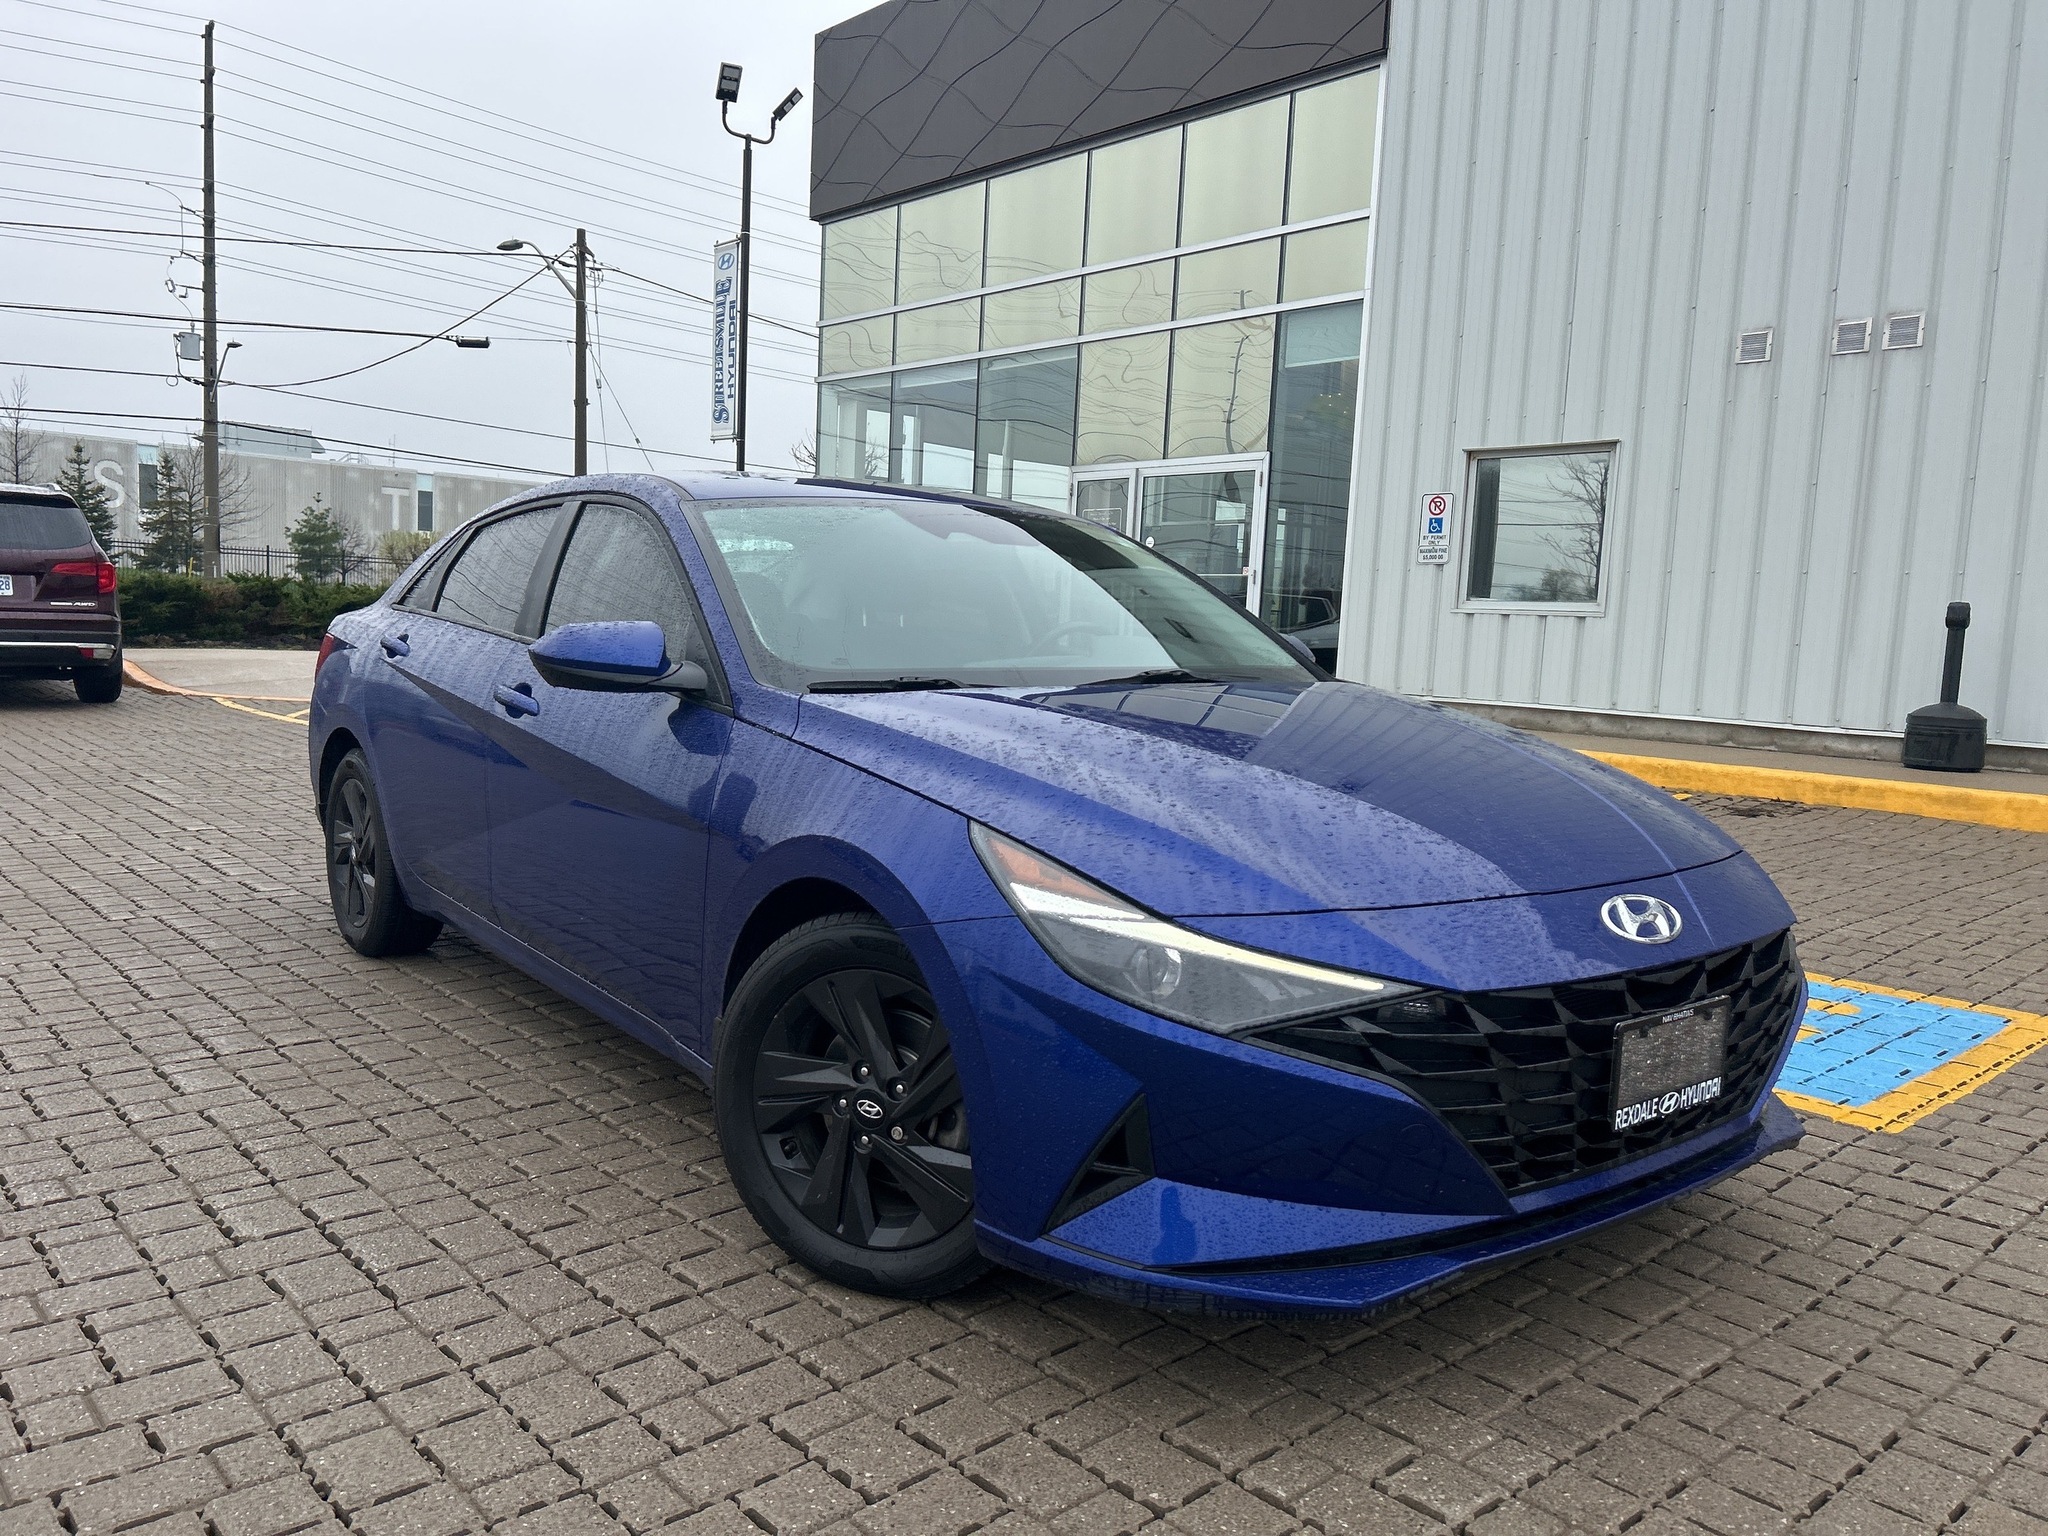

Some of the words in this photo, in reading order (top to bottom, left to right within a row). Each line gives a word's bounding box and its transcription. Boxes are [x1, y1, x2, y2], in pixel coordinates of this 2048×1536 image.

[713, 277, 732, 423] STREETSVILLE
[727, 300, 736, 399] HYUNDAI
[381, 486, 410, 531] T
[1614, 1097, 1659, 1131] REXDALE
[1680, 1076, 1722, 1109] HYUNDAI
